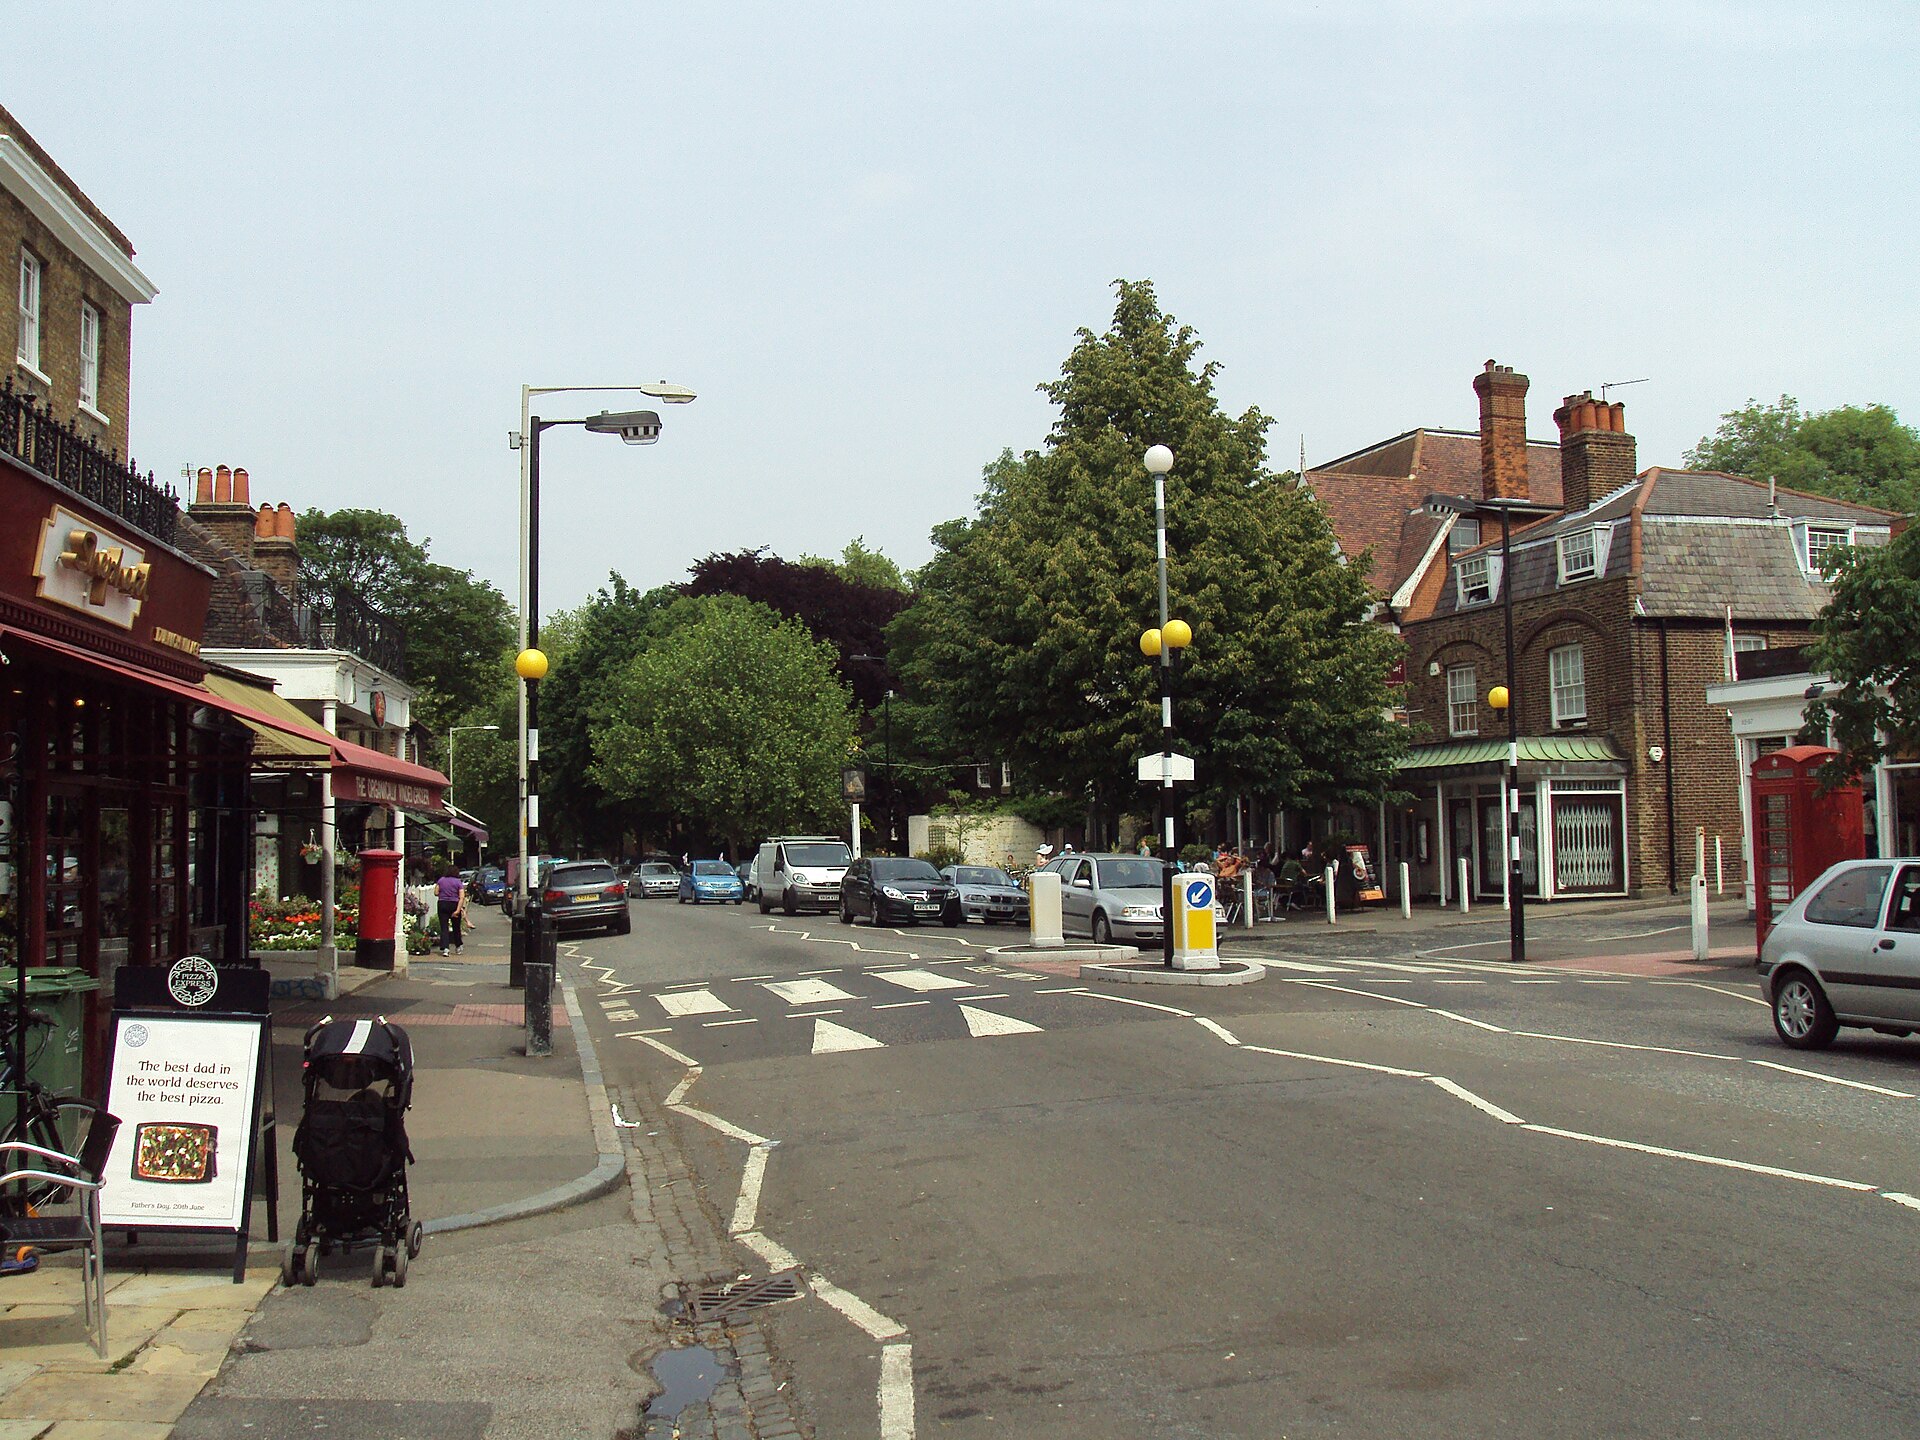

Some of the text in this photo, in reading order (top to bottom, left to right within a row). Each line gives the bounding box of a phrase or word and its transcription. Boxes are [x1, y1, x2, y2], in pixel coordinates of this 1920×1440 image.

[355, 776, 366, 798] THE
[138, 1060, 231, 1075] The best dad in
[126, 1074, 239, 1090] the world deserves
[137, 1090, 224, 1107] the best pizza.
